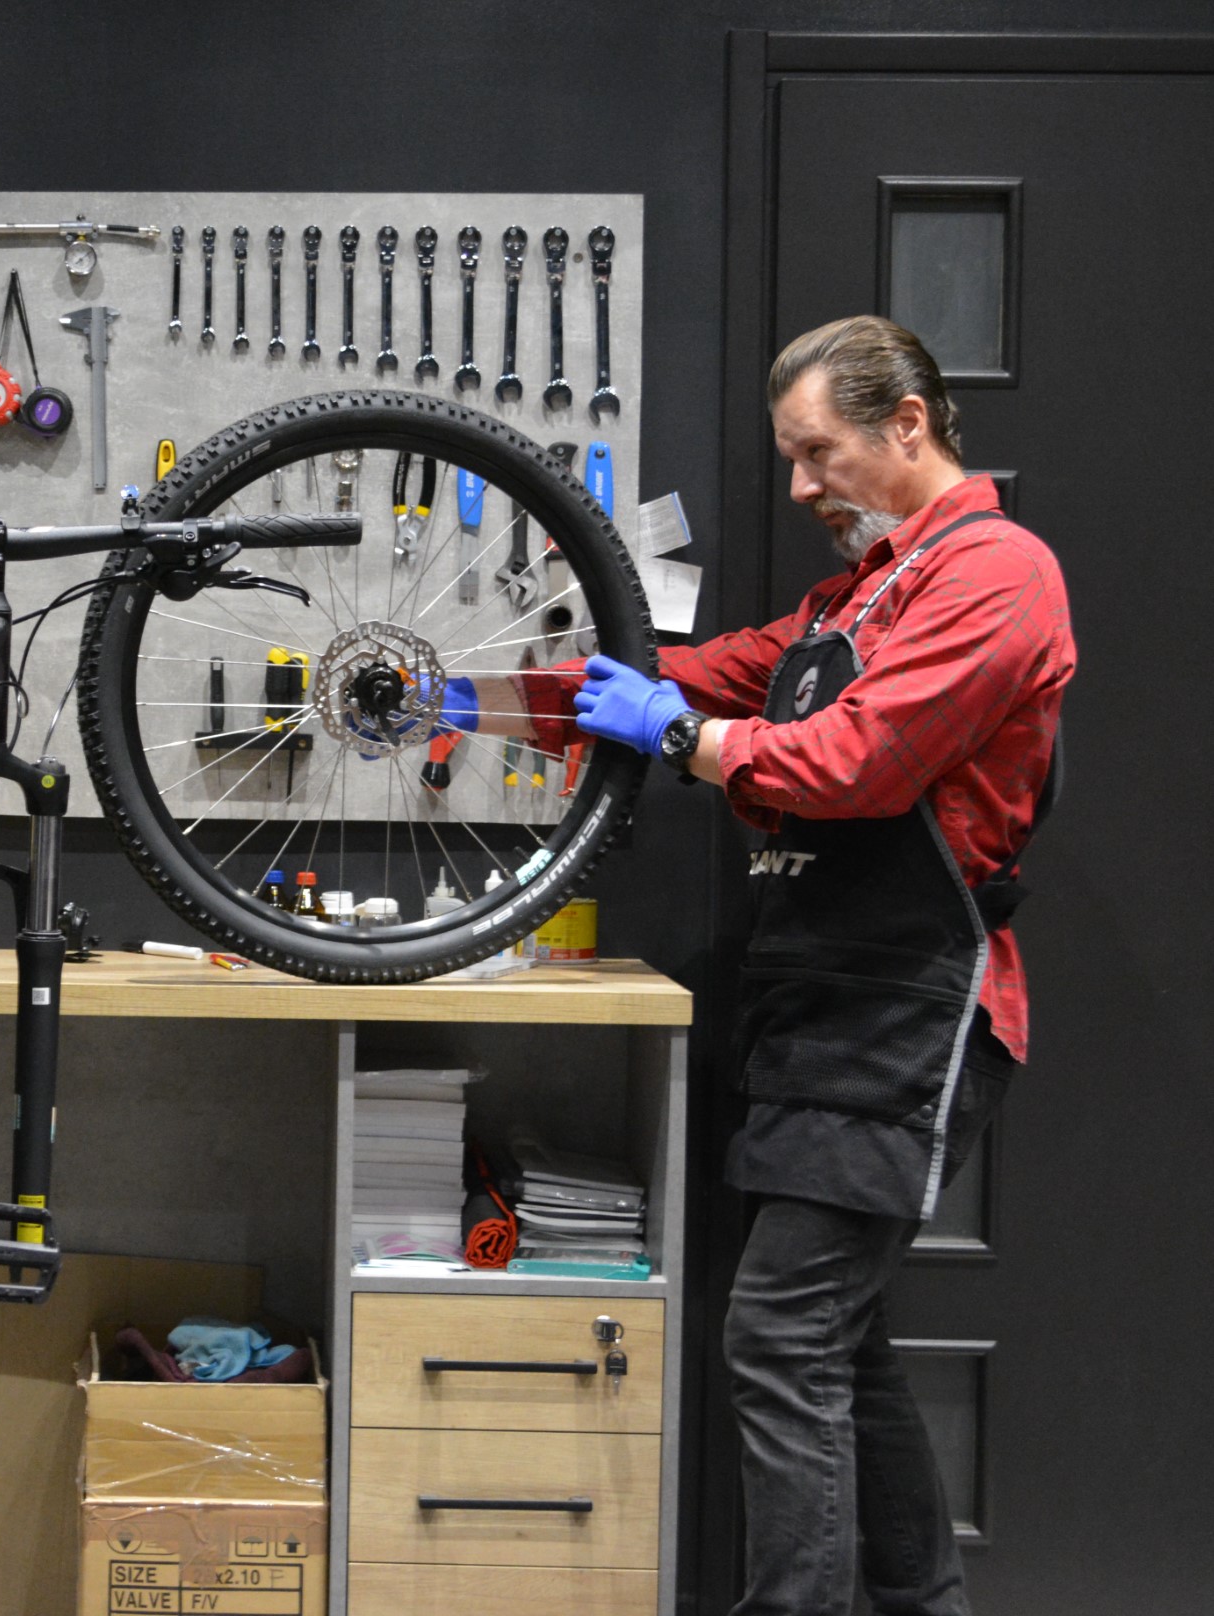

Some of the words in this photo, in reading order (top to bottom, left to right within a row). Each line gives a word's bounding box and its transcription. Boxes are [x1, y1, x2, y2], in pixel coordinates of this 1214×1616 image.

[472, 792, 612, 936] SCHWALBE
[748, 850, 817, 876] IANT
[114, 1566, 158, 1584] SIZE
[114, 1592, 172, 1609] VALVE
[191, 1593, 219, 1610] F/V
